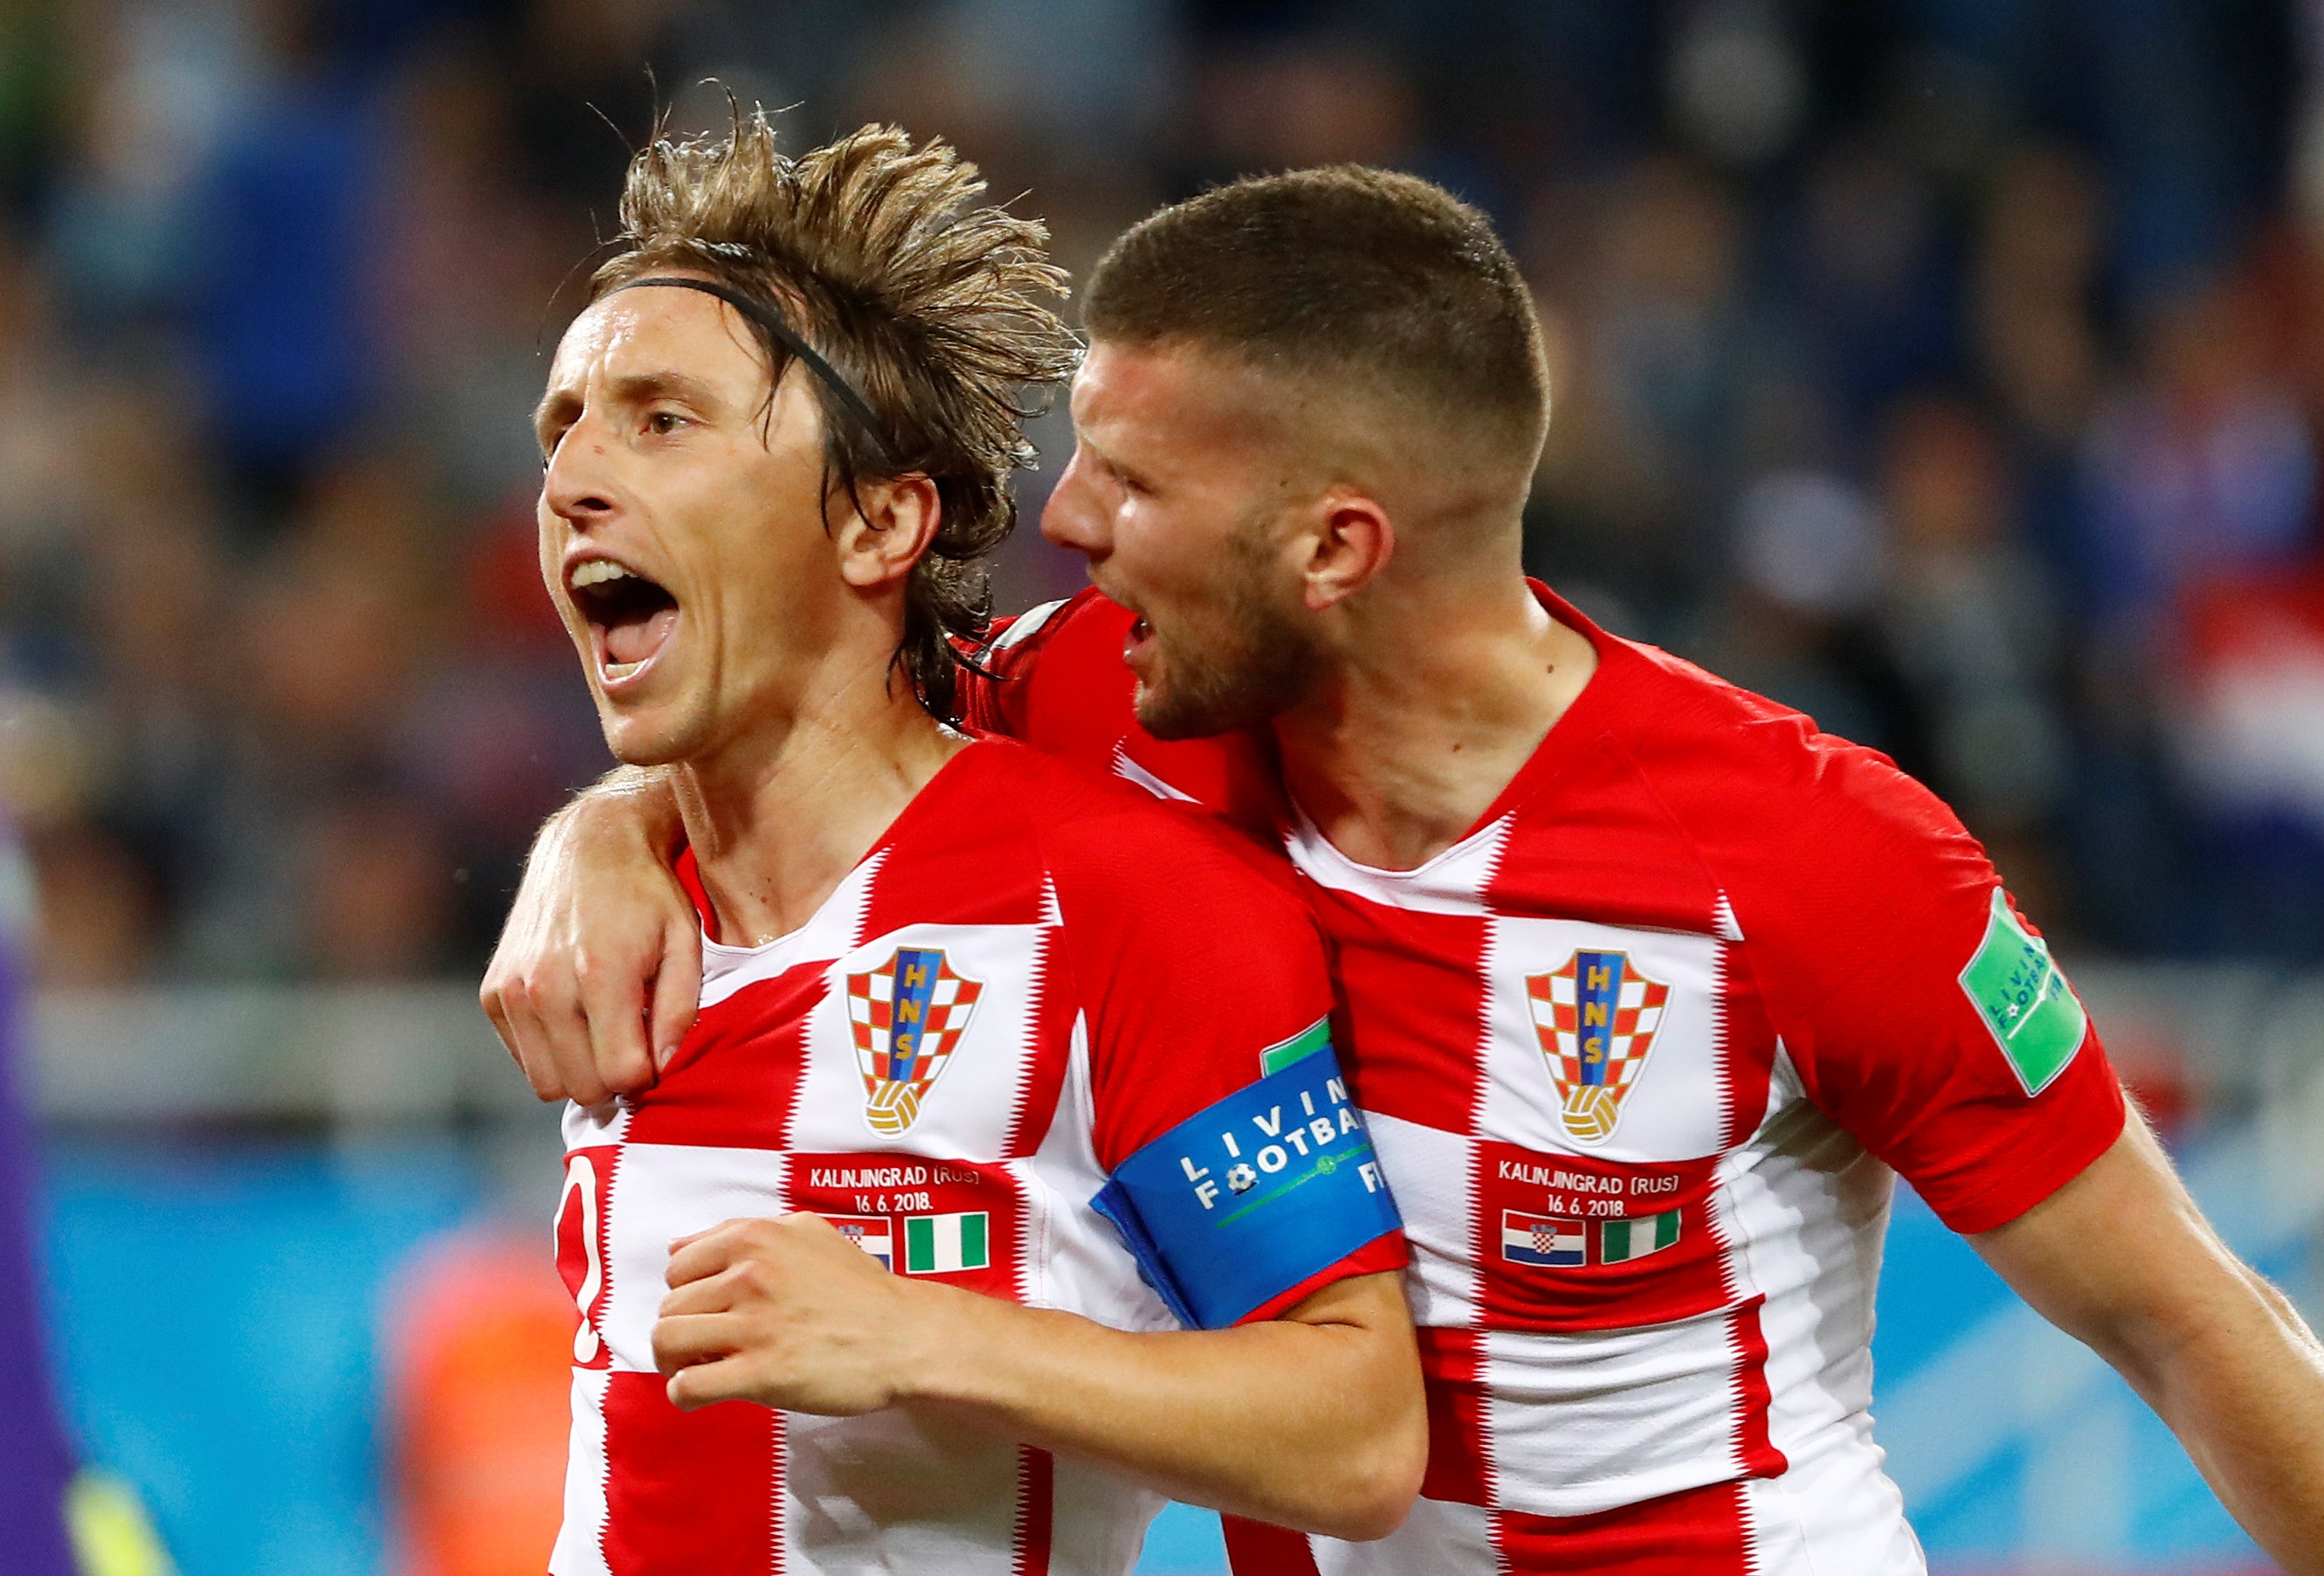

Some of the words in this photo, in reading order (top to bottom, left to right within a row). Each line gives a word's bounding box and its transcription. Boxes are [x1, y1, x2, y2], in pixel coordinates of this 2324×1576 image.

[896, 964, 928, 1061] HNS
[1584, 965, 1610, 1064] HNS
[810, 1166, 928, 1188] KALINJINGRAD
[1498, 1160, 1624, 1194] KALINJINGRAD
